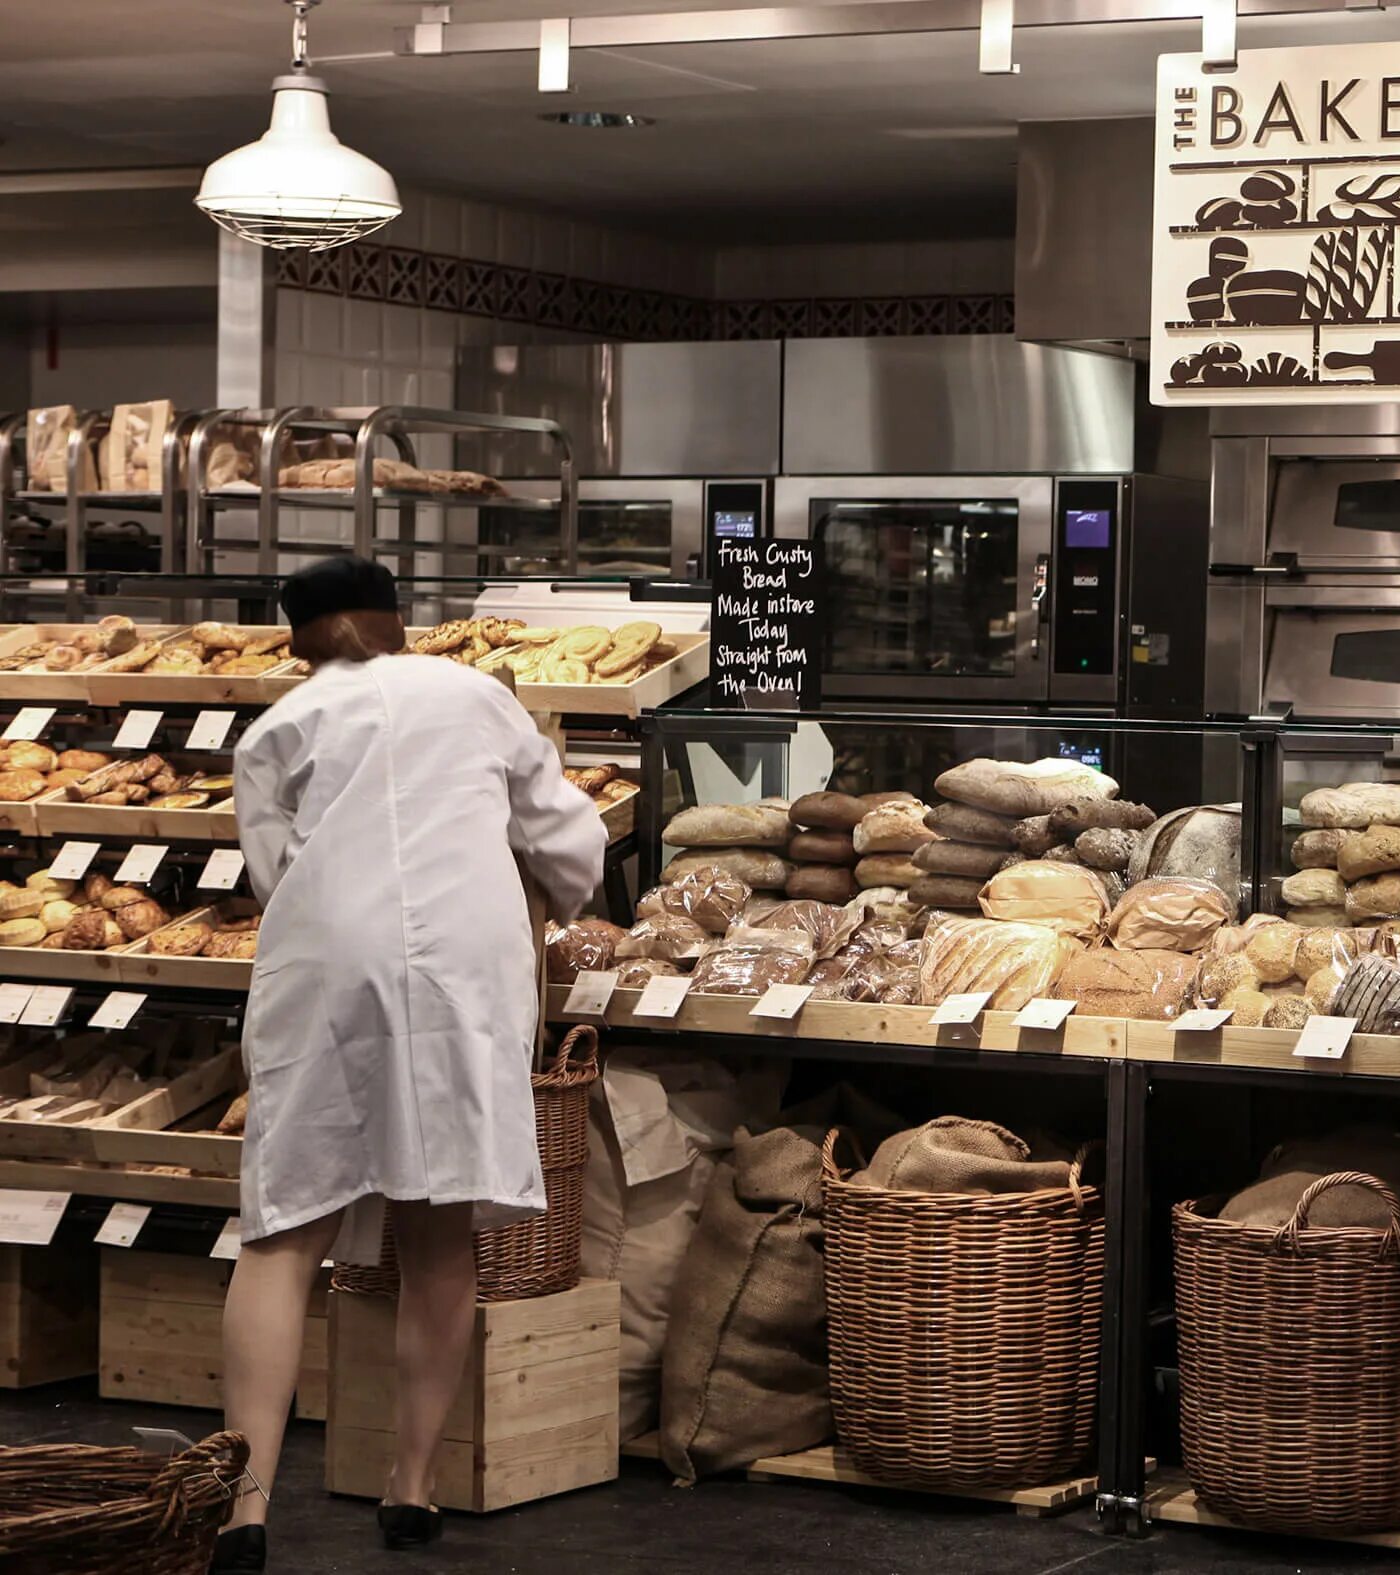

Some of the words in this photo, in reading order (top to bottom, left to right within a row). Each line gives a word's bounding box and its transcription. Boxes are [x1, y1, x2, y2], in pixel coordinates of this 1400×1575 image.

[1173, 86, 1196, 150] THE
[719, 540, 758, 567] Fresh
[767, 543, 812, 578] Crusty
[743, 566, 786, 589] Bread
[719, 594, 758, 617] Made
[768, 593, 814, 613] instore
[739, 618, 787, 646] Today
[717, 645, 771, 674] Straight
[776, 647, 806, 667] from
[718, 674, 746, 695] the
[758, 672, 801, 699] Oven!
